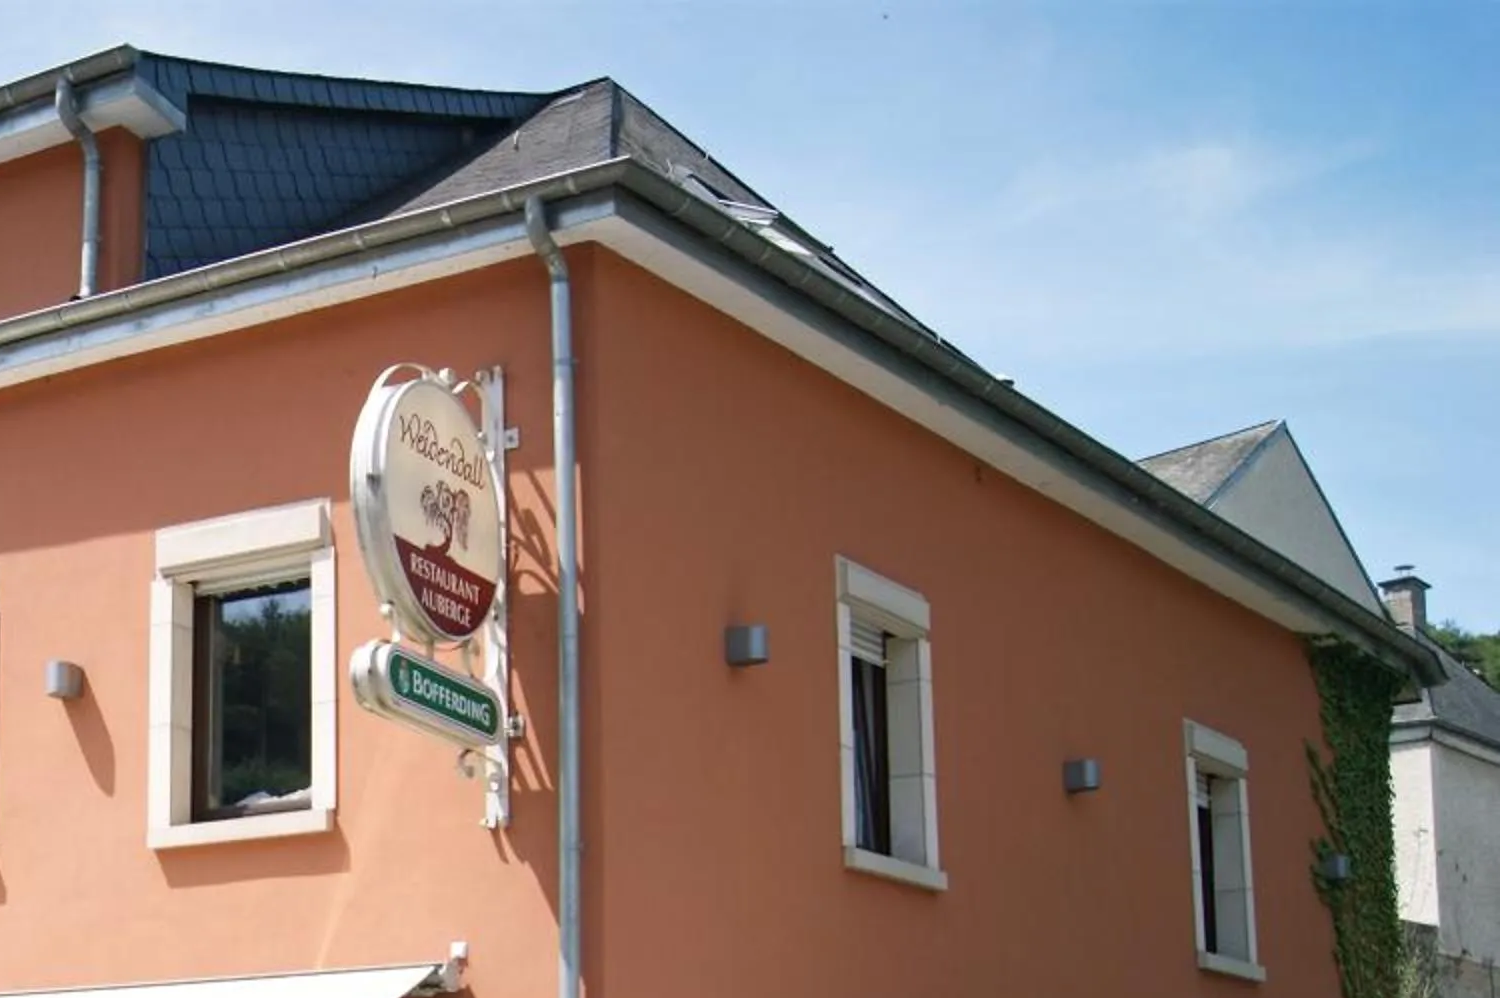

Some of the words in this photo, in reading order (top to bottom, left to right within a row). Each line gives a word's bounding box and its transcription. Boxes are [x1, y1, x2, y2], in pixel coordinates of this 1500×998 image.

[398, 412, 485, 490] Weidendall
[410, 552, 481, 605] RESTAURANT
[421, 588, 473, 629] AUBERGE
[413, 670, 490, 726] BOFFERDING
